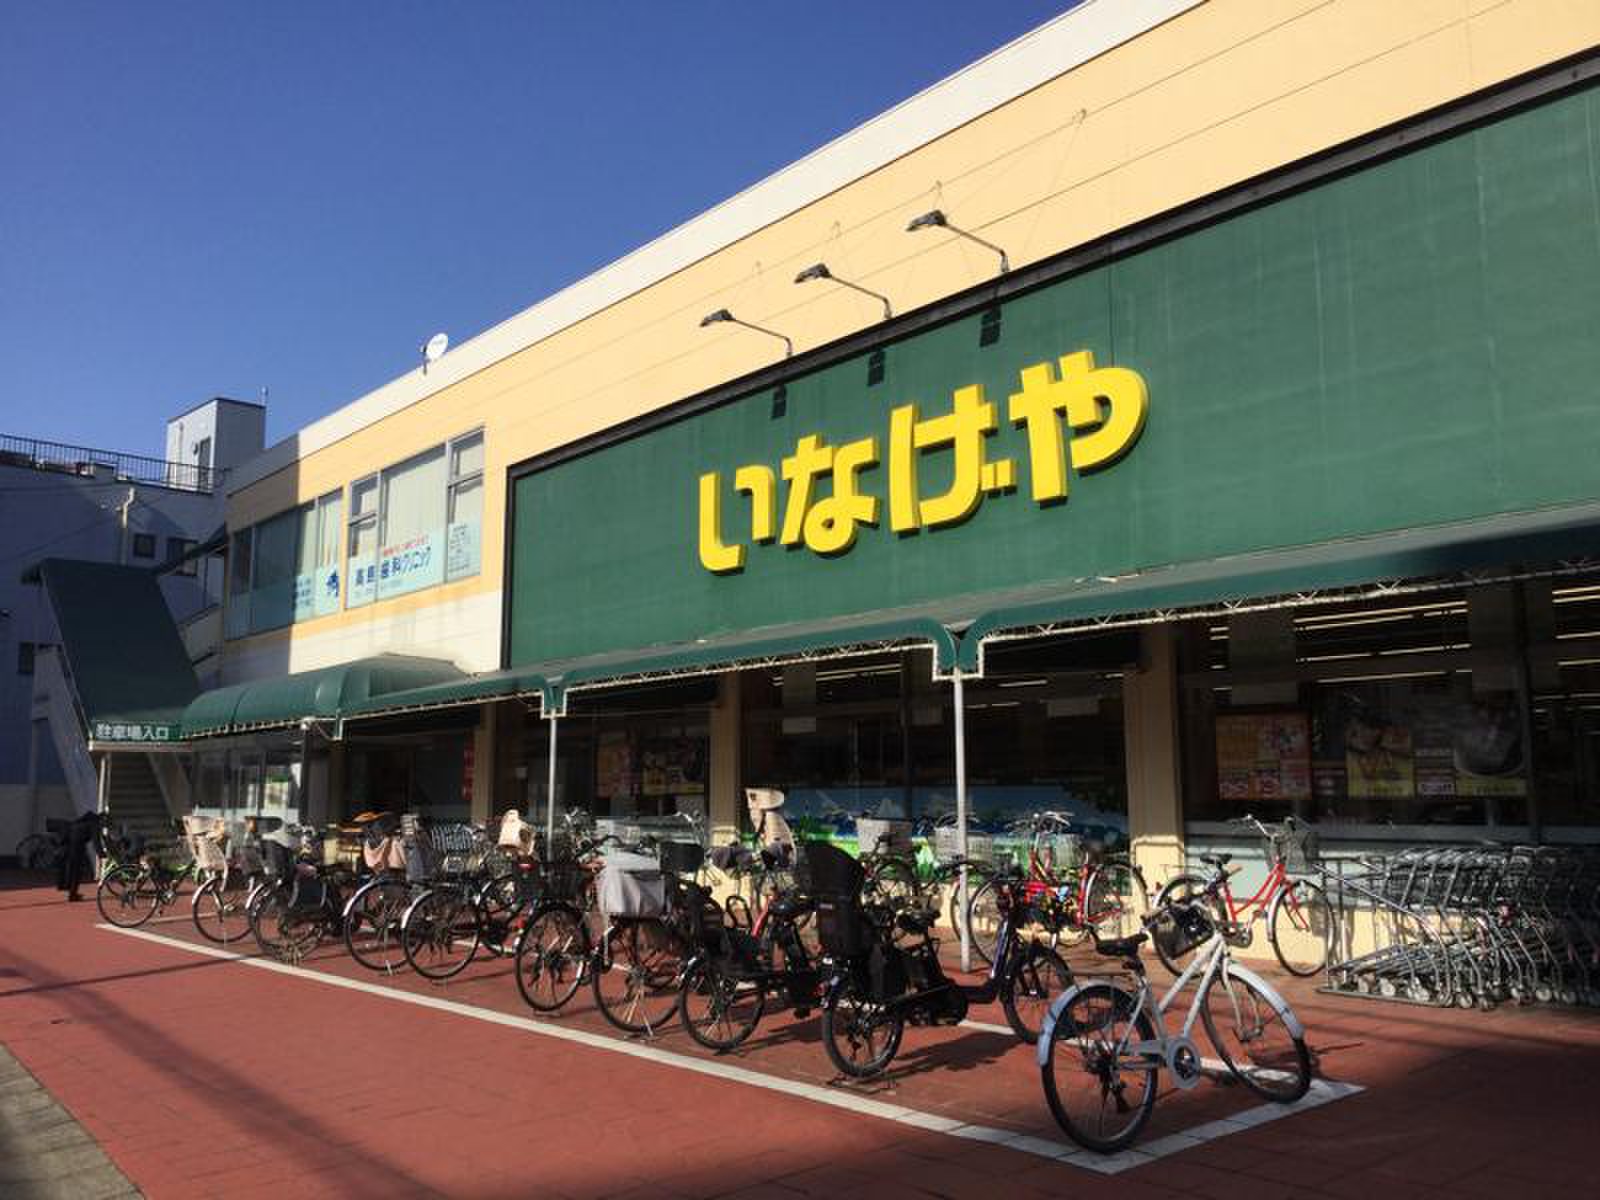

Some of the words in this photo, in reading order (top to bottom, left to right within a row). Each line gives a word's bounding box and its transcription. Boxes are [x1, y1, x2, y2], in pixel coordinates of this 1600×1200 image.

[699, 351, 1148, 572] いなげや
[96, 724, 169, 740] 駐車場入口
